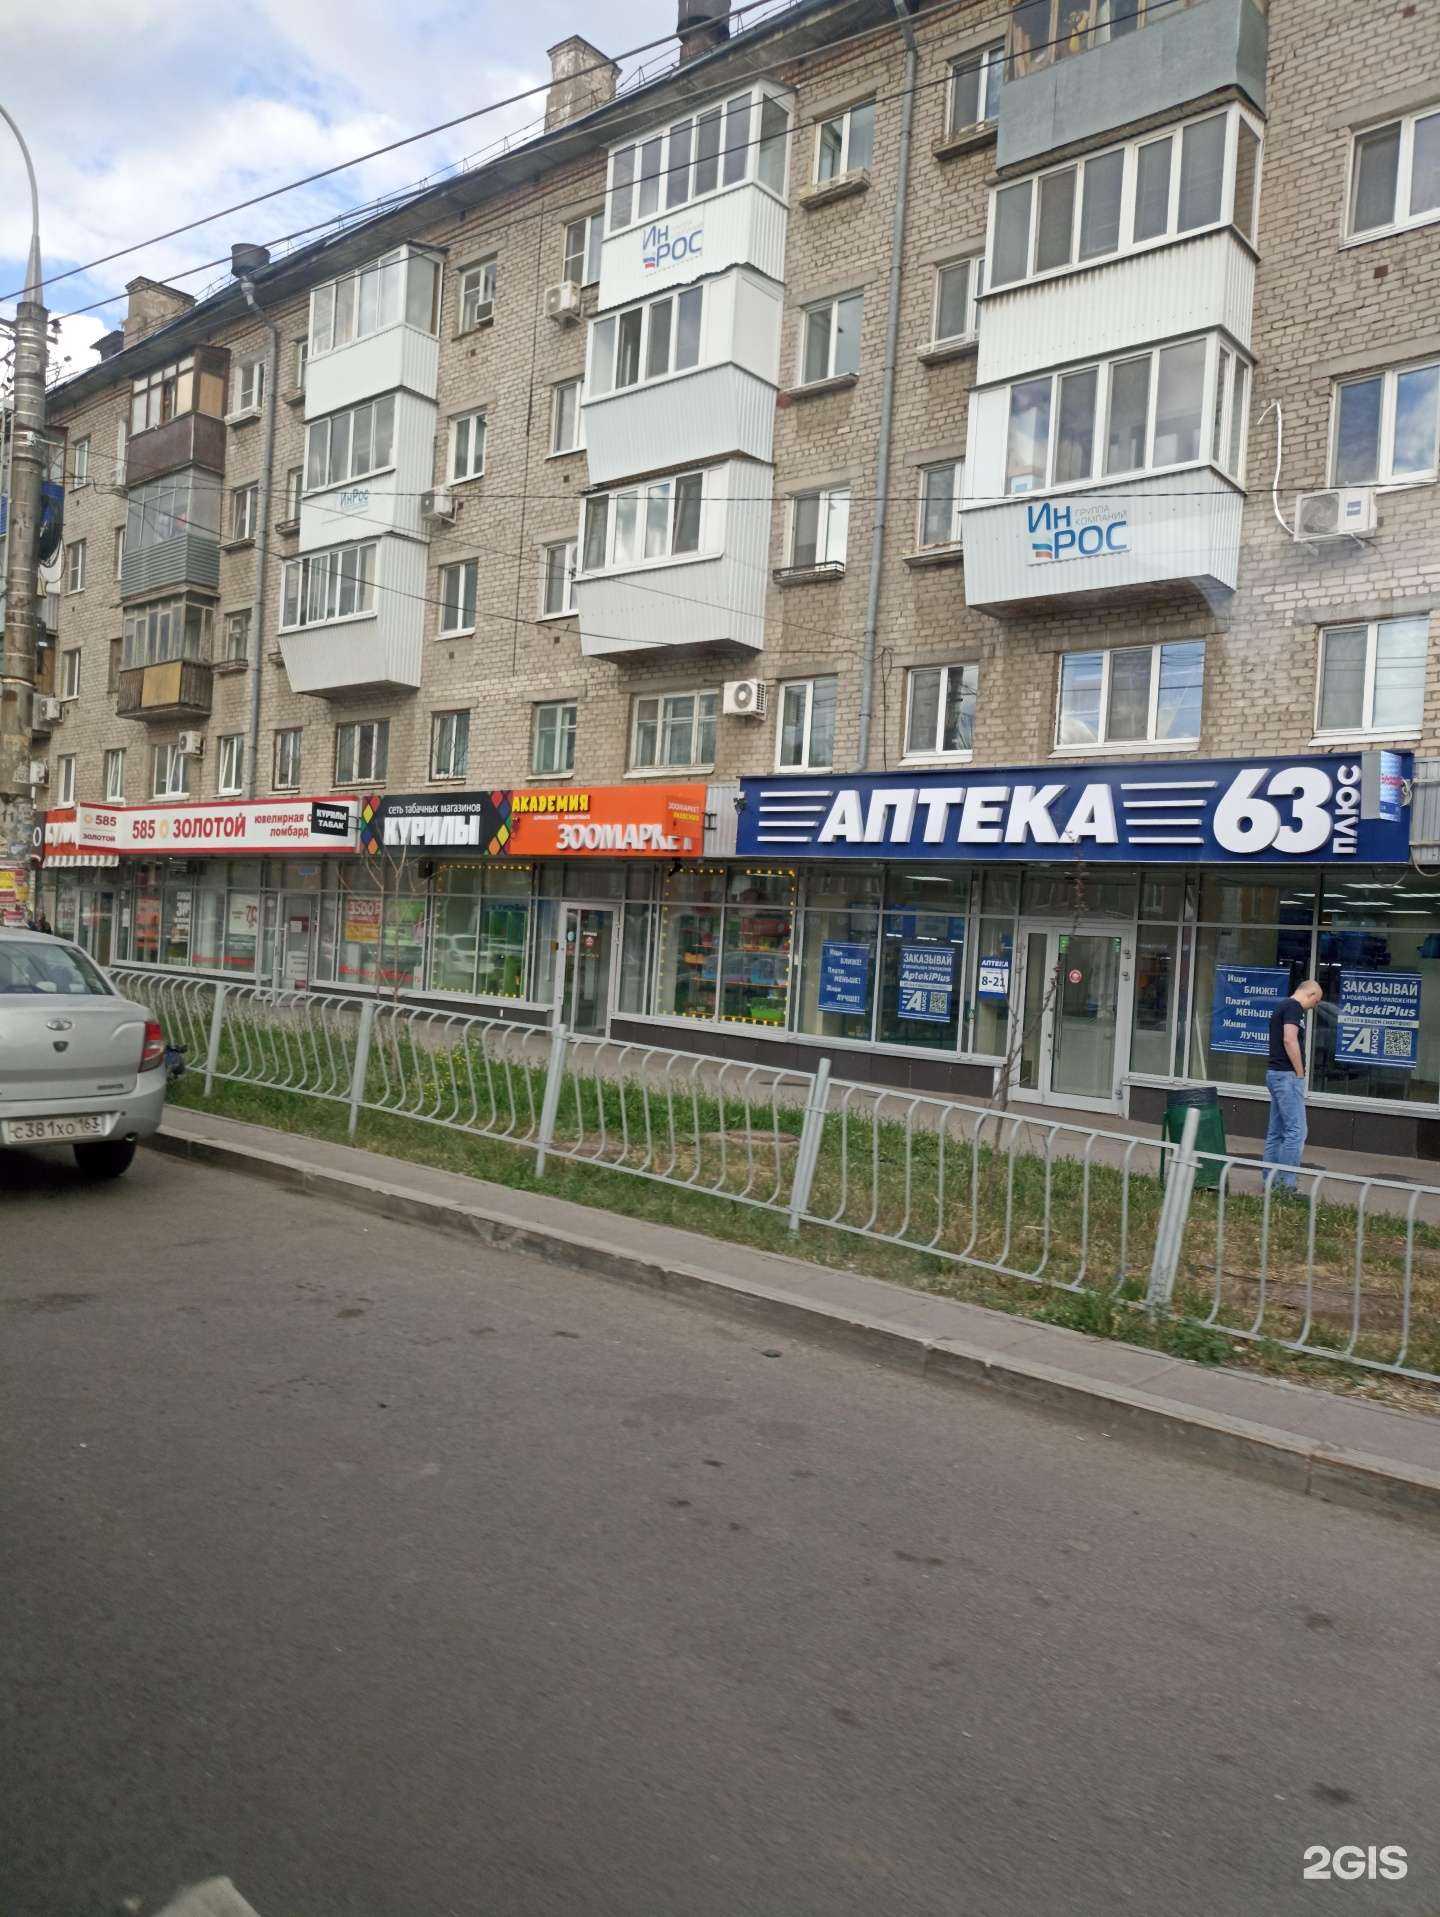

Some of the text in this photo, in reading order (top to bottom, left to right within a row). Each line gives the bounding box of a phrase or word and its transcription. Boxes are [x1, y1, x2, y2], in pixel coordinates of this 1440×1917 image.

[656, 229, 703, 268] РОС
[1054, 520, 1127, 559] РОС
[388, 803, 481, 815] сеть табачных магазинов
[511, 793, 591, 813] АКАДЕМИЯ
[1332, 764, 1361, 854] ПЛЮС
[316, 808, 347, 820] КУРИЛЫ
[816, 766, 1334, 855] АПТЕКА 63
[95, 815, 117, 827] 585
[132, 813, 247, 839] 585 ЗОЛОТОЙ
[254, 813, 304, 826] ювелирная
[318, 820, 345, 829] ТАБАК
[270, 825, 309, 838] ломбард
[383, 815, 480, 846] КУРИЛЫ
[903, 953, 952, 966] ЗАКАЗЫВАЙ
[981, 960, 1009, 968] АПТЕКА
[902, 971, 951, 983] AptekiPlus
[981, 975, 1006, 988] 8-21
[1244, 985, 1279, 996] БЛИЖЕ!
[1342, 979, 1418, 996] ЗАКАЗЫВАЙ
[1225, 996, 1251, 1006] Плати
[1342, 1002, 1417, 1017] AptekiPlus
[1239, 1031, 1270, 1041] ЛУЧШ
